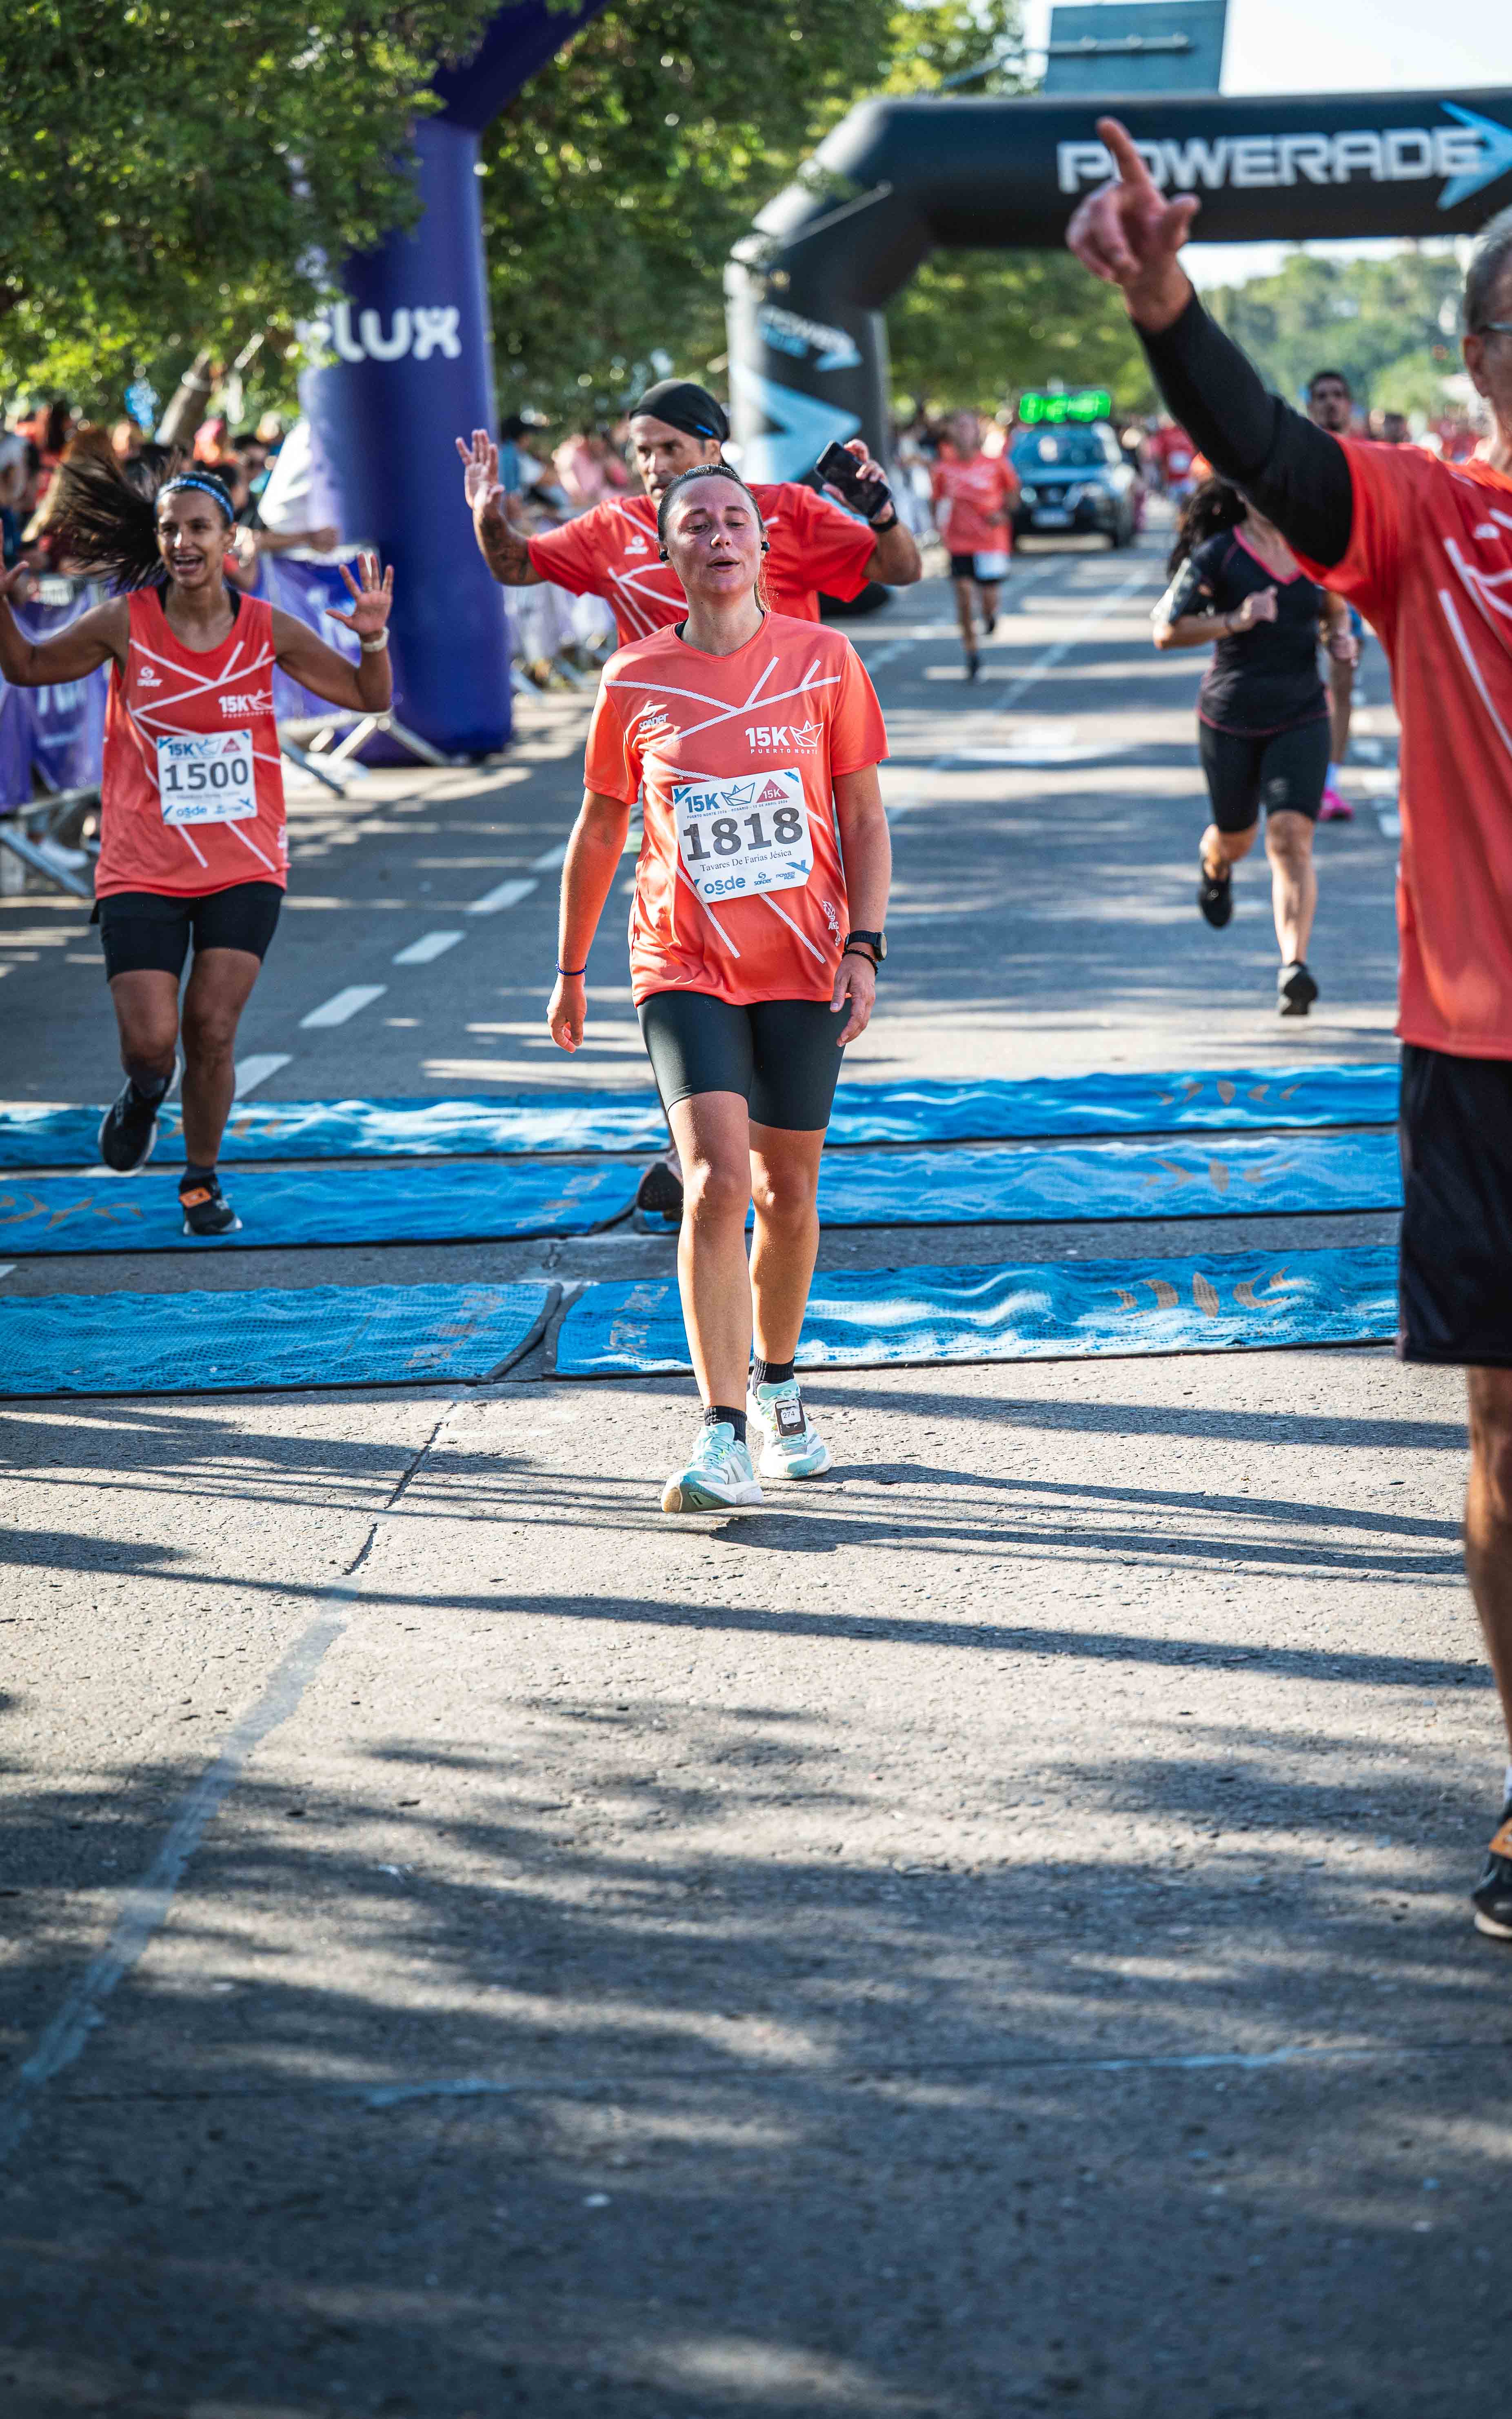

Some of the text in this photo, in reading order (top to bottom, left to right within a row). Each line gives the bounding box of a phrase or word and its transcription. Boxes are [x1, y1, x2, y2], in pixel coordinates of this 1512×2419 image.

[218, 694, 249, 713] 15K
[745, 726, 790, 747] 15K
[168, 743, 194, 755] 15K
[164, 758, 249, 792] 1500
[685, 793, 720, 813] 15K
[763, 789, 781, 799] 15K
[683, 807, 803, 861] 1818
[700, 849, 792, 872] Tavares De Farias Jésica
[704, 875, 746, 895] osde
